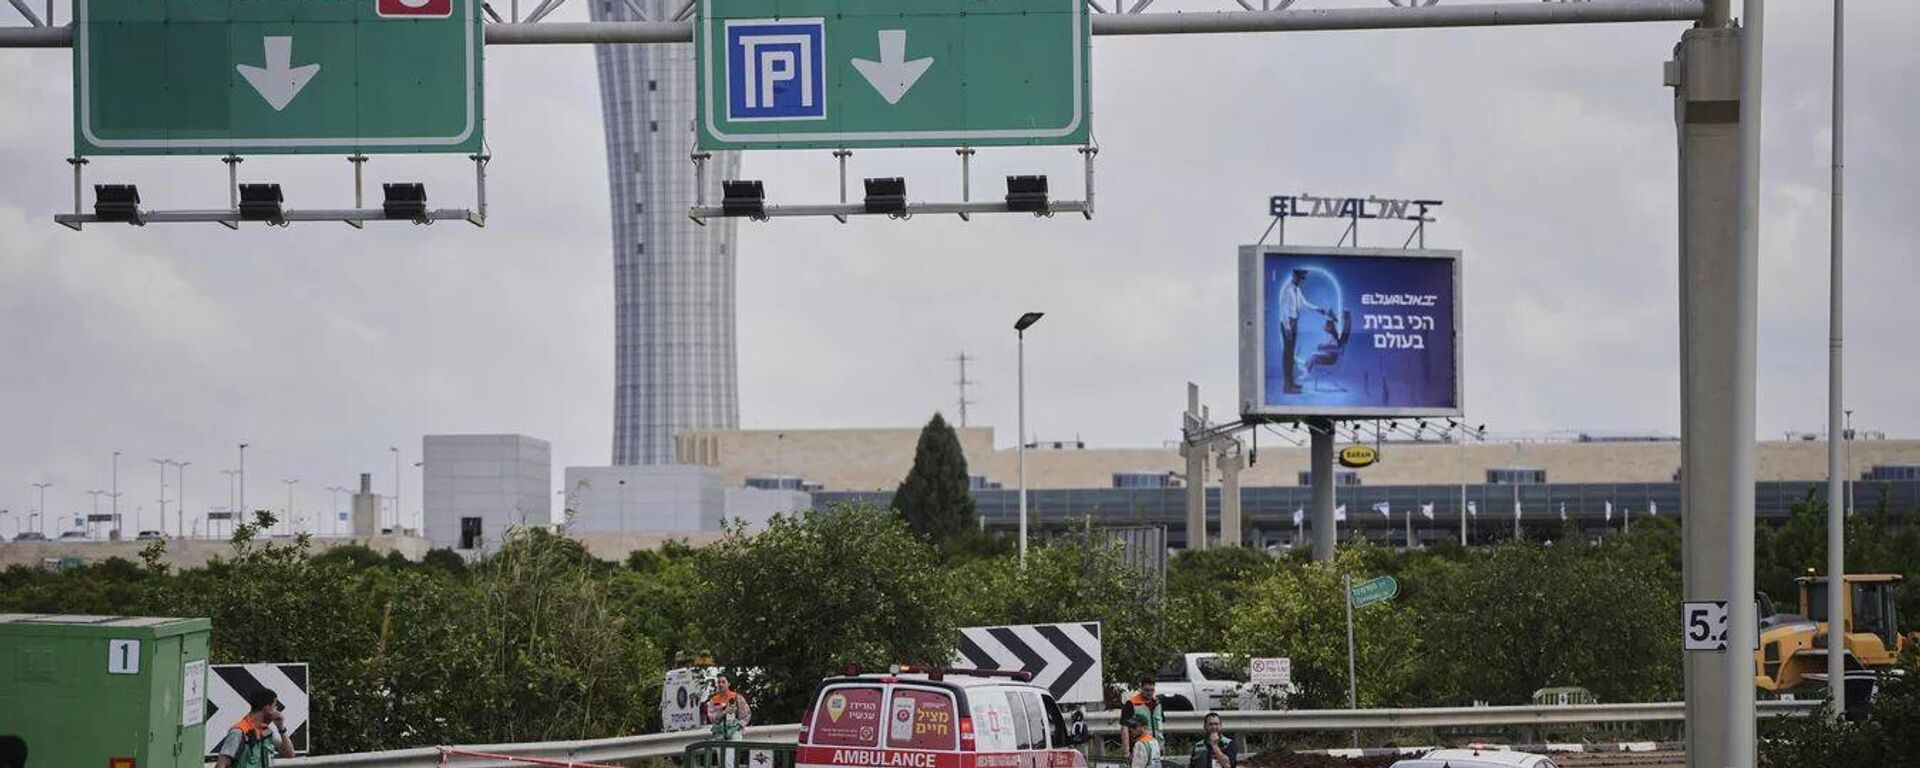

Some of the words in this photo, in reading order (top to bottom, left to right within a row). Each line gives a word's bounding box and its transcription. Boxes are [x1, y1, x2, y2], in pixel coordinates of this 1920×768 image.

[1363, 314, 1405, 330] בבית
[1408, 315, 1435, 330] הכי
[1373, 332, 1424, 349] בעולם
[121, 643, 129, 670] 1
[917, 707, 949, 723] מציל
[916, 722, 948, 736] חיים
[832, 749, 936, 768] AMBULANCE
